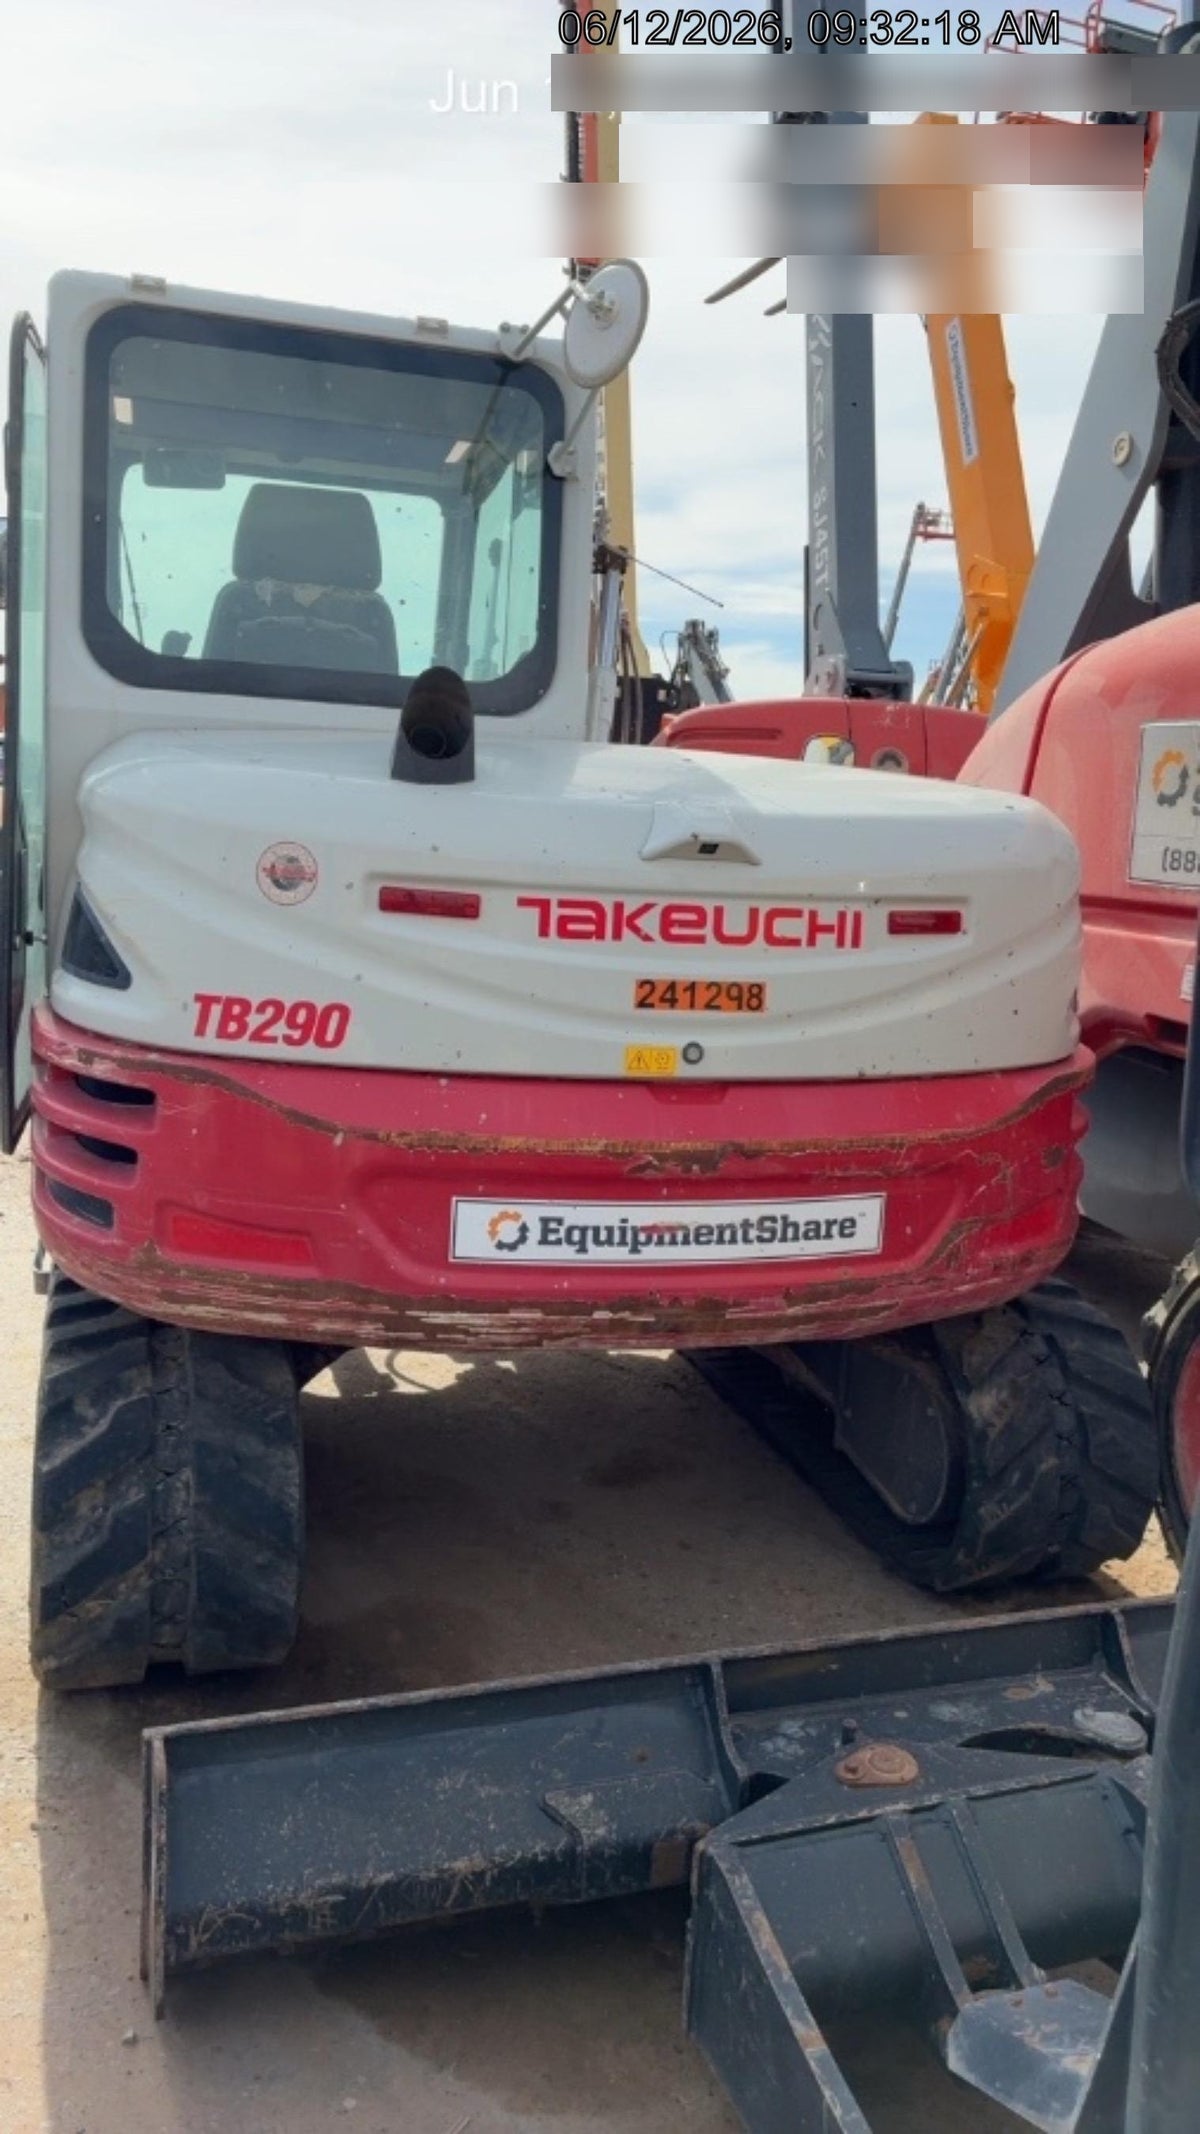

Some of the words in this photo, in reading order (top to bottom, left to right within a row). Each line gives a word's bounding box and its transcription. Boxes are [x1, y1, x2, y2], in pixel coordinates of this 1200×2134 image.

[1161, 846, 1200, 874] (88
[516, 895, 865, 950] TAKEUCHI
[635, 979, 764, 1011] 241298
[192, 992, 352, 1050] TB290
[537, 1212, 858, 1255] EquipmentShare
